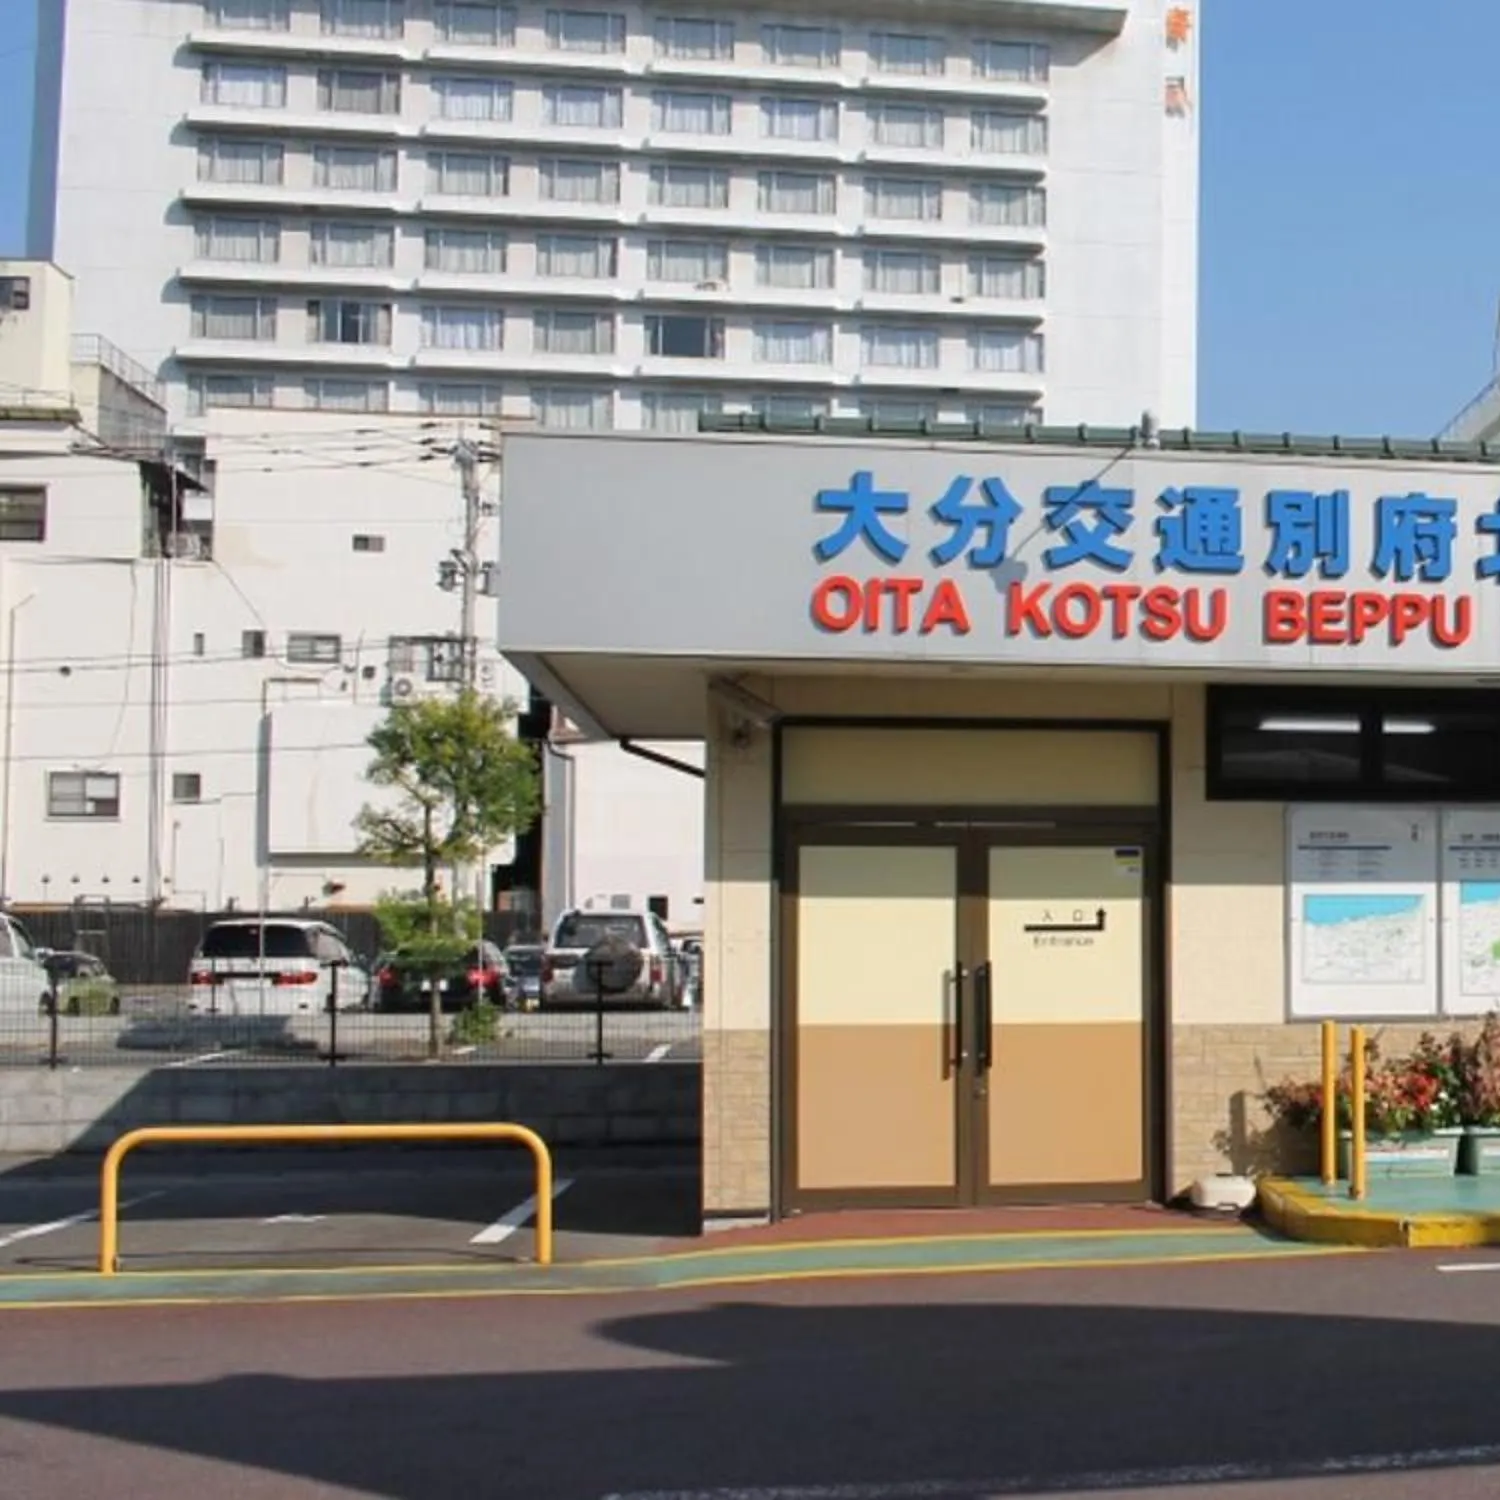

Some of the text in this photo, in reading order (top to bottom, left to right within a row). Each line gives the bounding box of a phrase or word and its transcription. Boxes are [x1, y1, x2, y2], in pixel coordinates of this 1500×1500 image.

[809, 574, 970, 637] OITA
[1005, 579, 1227, 643] KOTSU
[1263, 589, 1473, 647] BEPPU
